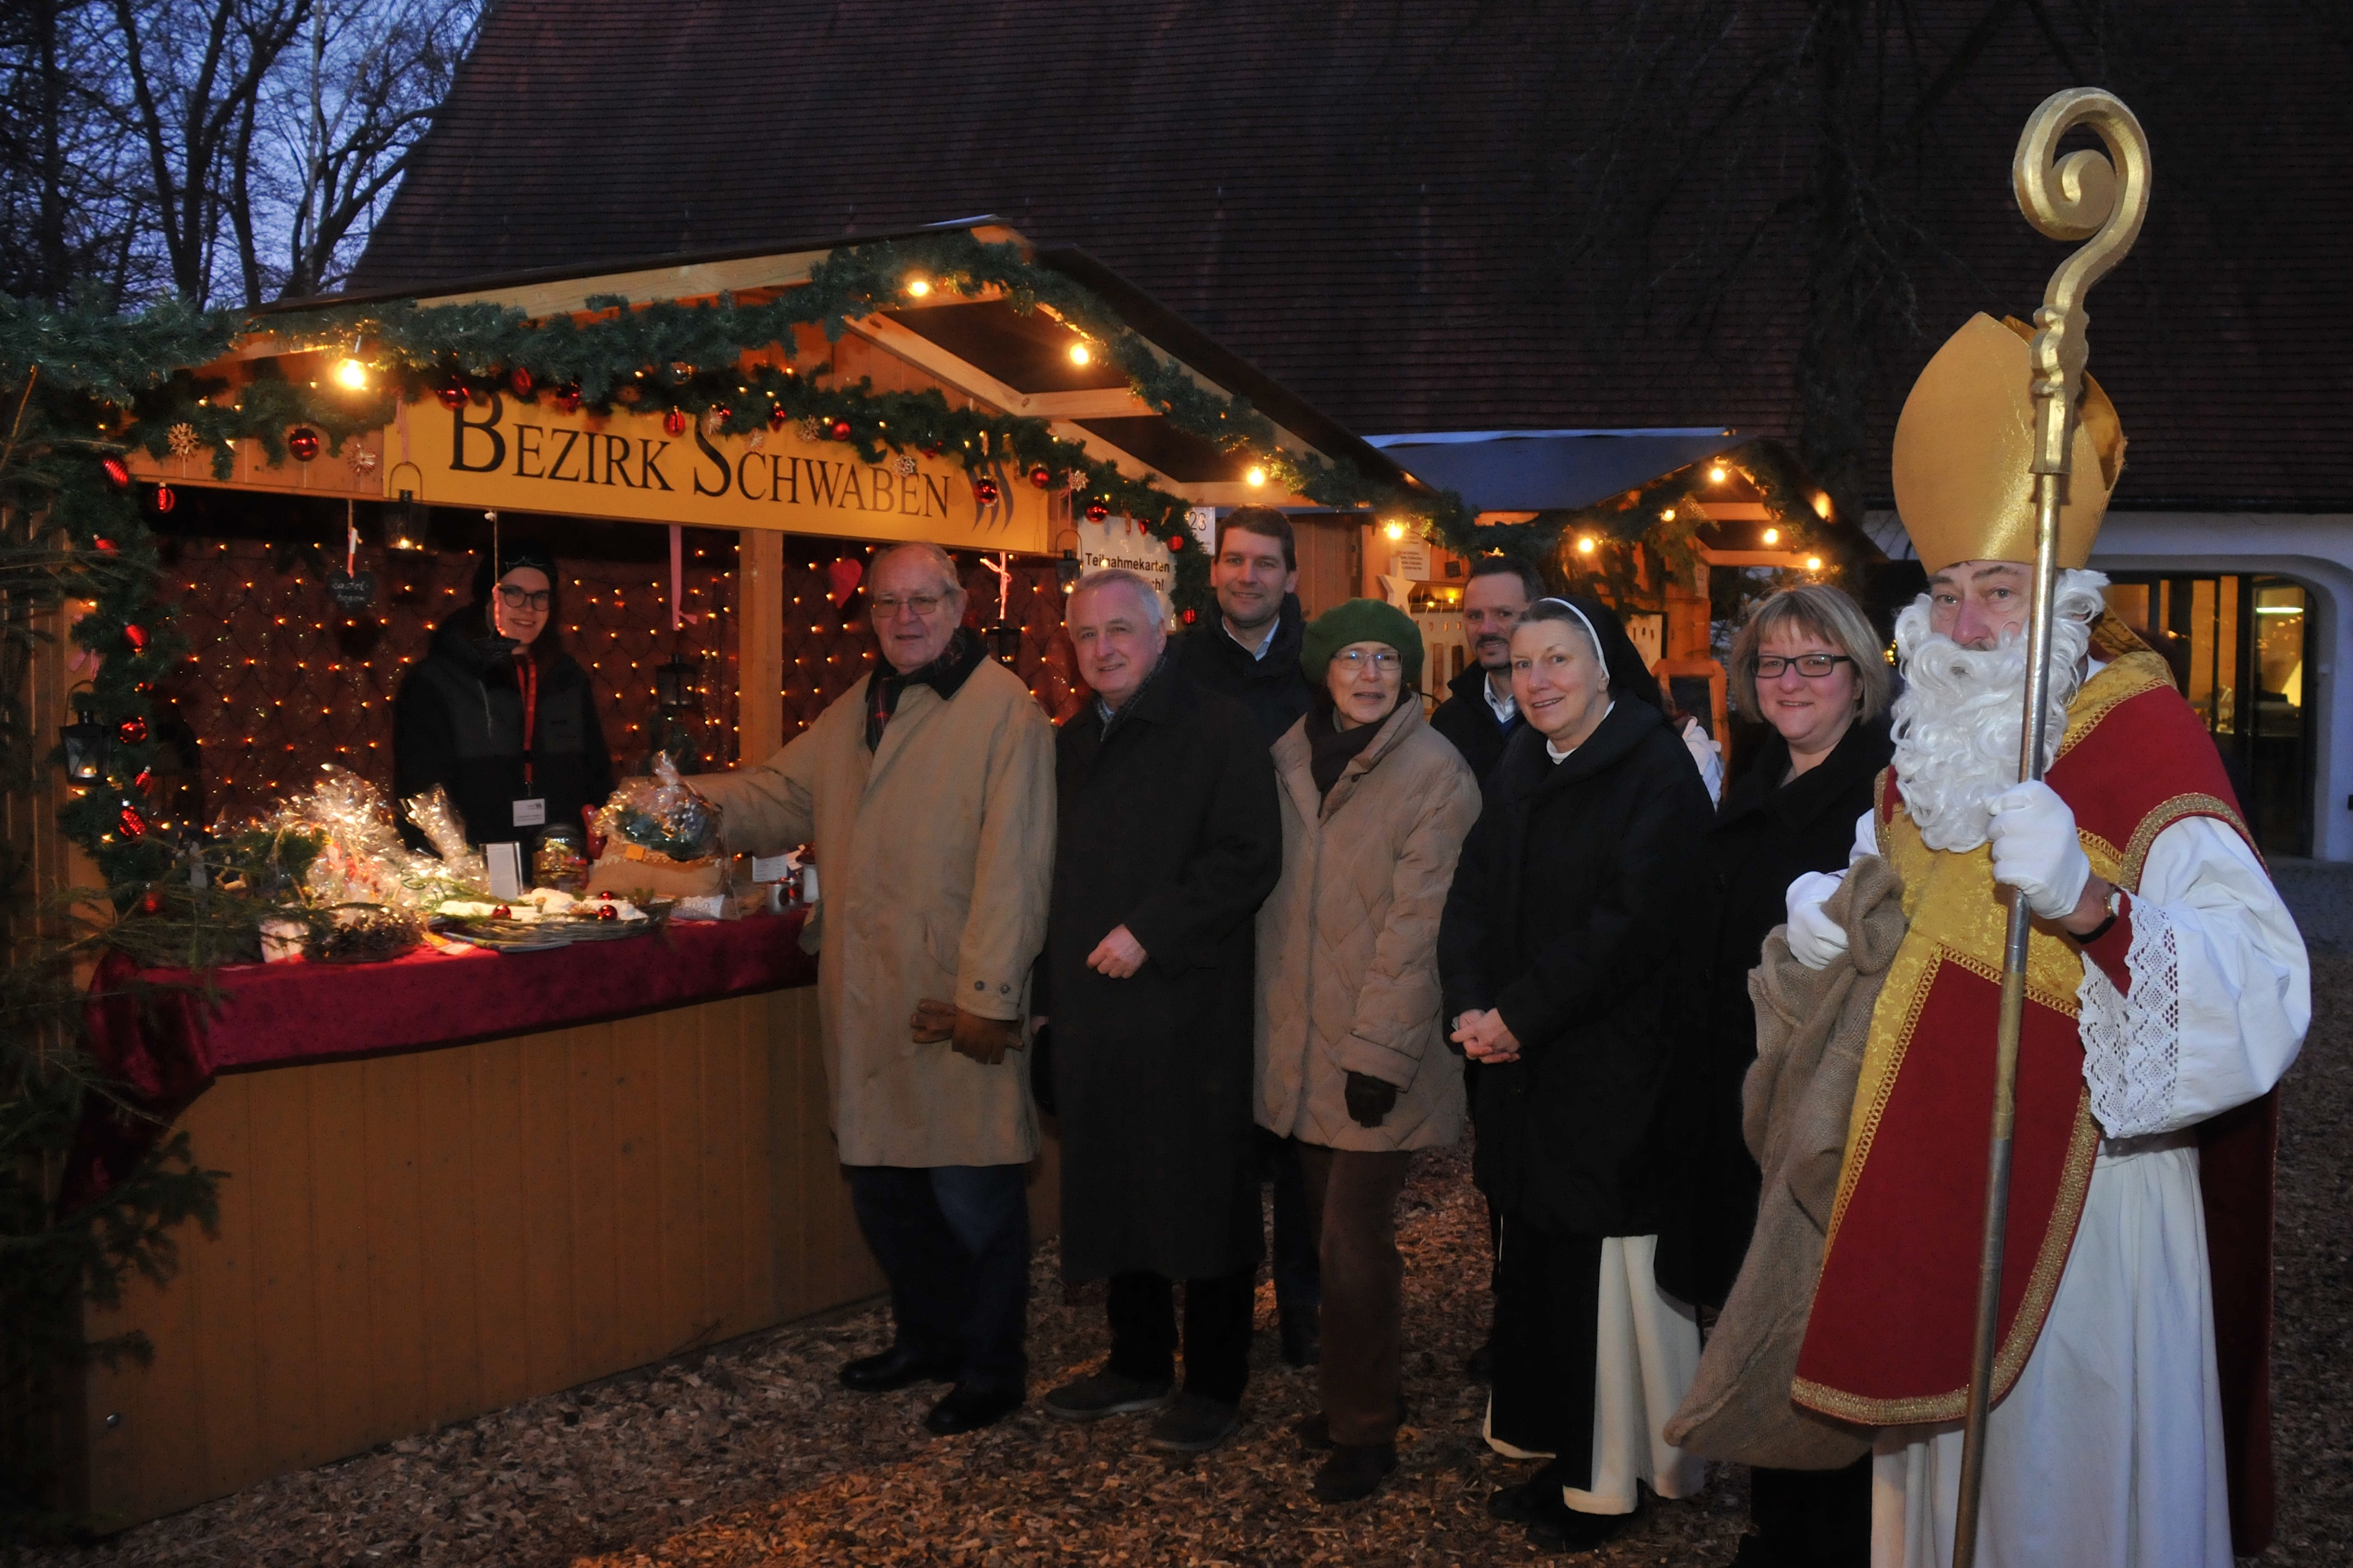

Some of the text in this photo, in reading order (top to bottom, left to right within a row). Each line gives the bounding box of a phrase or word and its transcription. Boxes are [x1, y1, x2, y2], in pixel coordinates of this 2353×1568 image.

[449, 393, 950, 519] BEZIRK SCHWABEN
[1085, 553, 1170, 573] Teilnahmekarten
